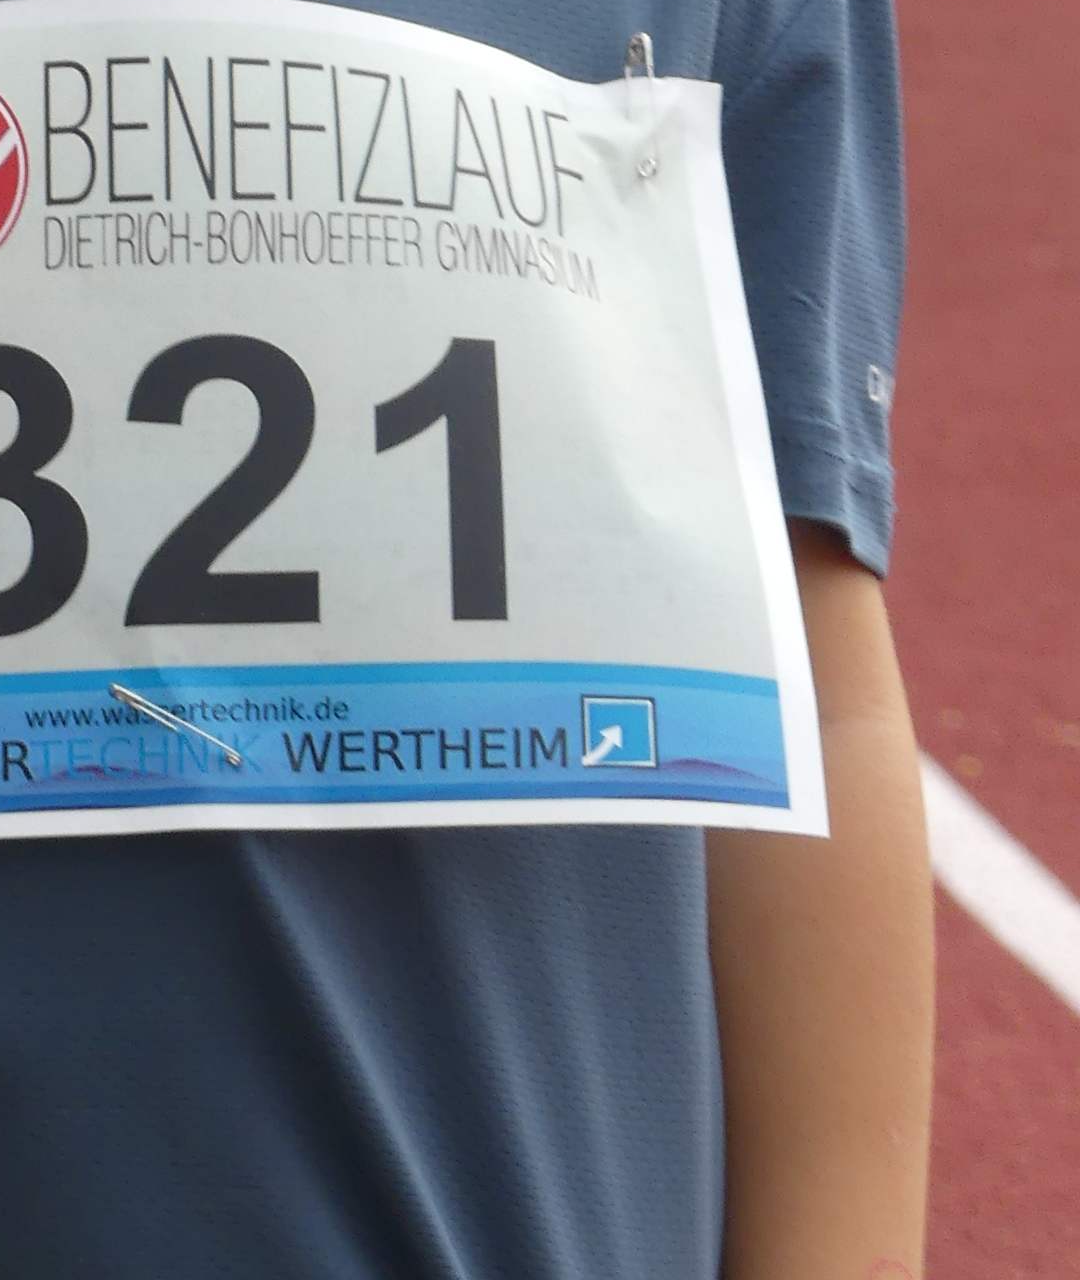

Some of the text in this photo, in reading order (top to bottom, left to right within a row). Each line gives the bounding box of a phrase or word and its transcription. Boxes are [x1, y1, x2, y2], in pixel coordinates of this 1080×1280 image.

[43, 54, 585, 238] BENEFIZLAUF
[43, 209, 602, 304] DIETRICH-BONHOEFFER GYMNASIUM
[24, 696, 350, 729] www.waertechnik.de
[282, 726, 570, 774] WERTHEIM
